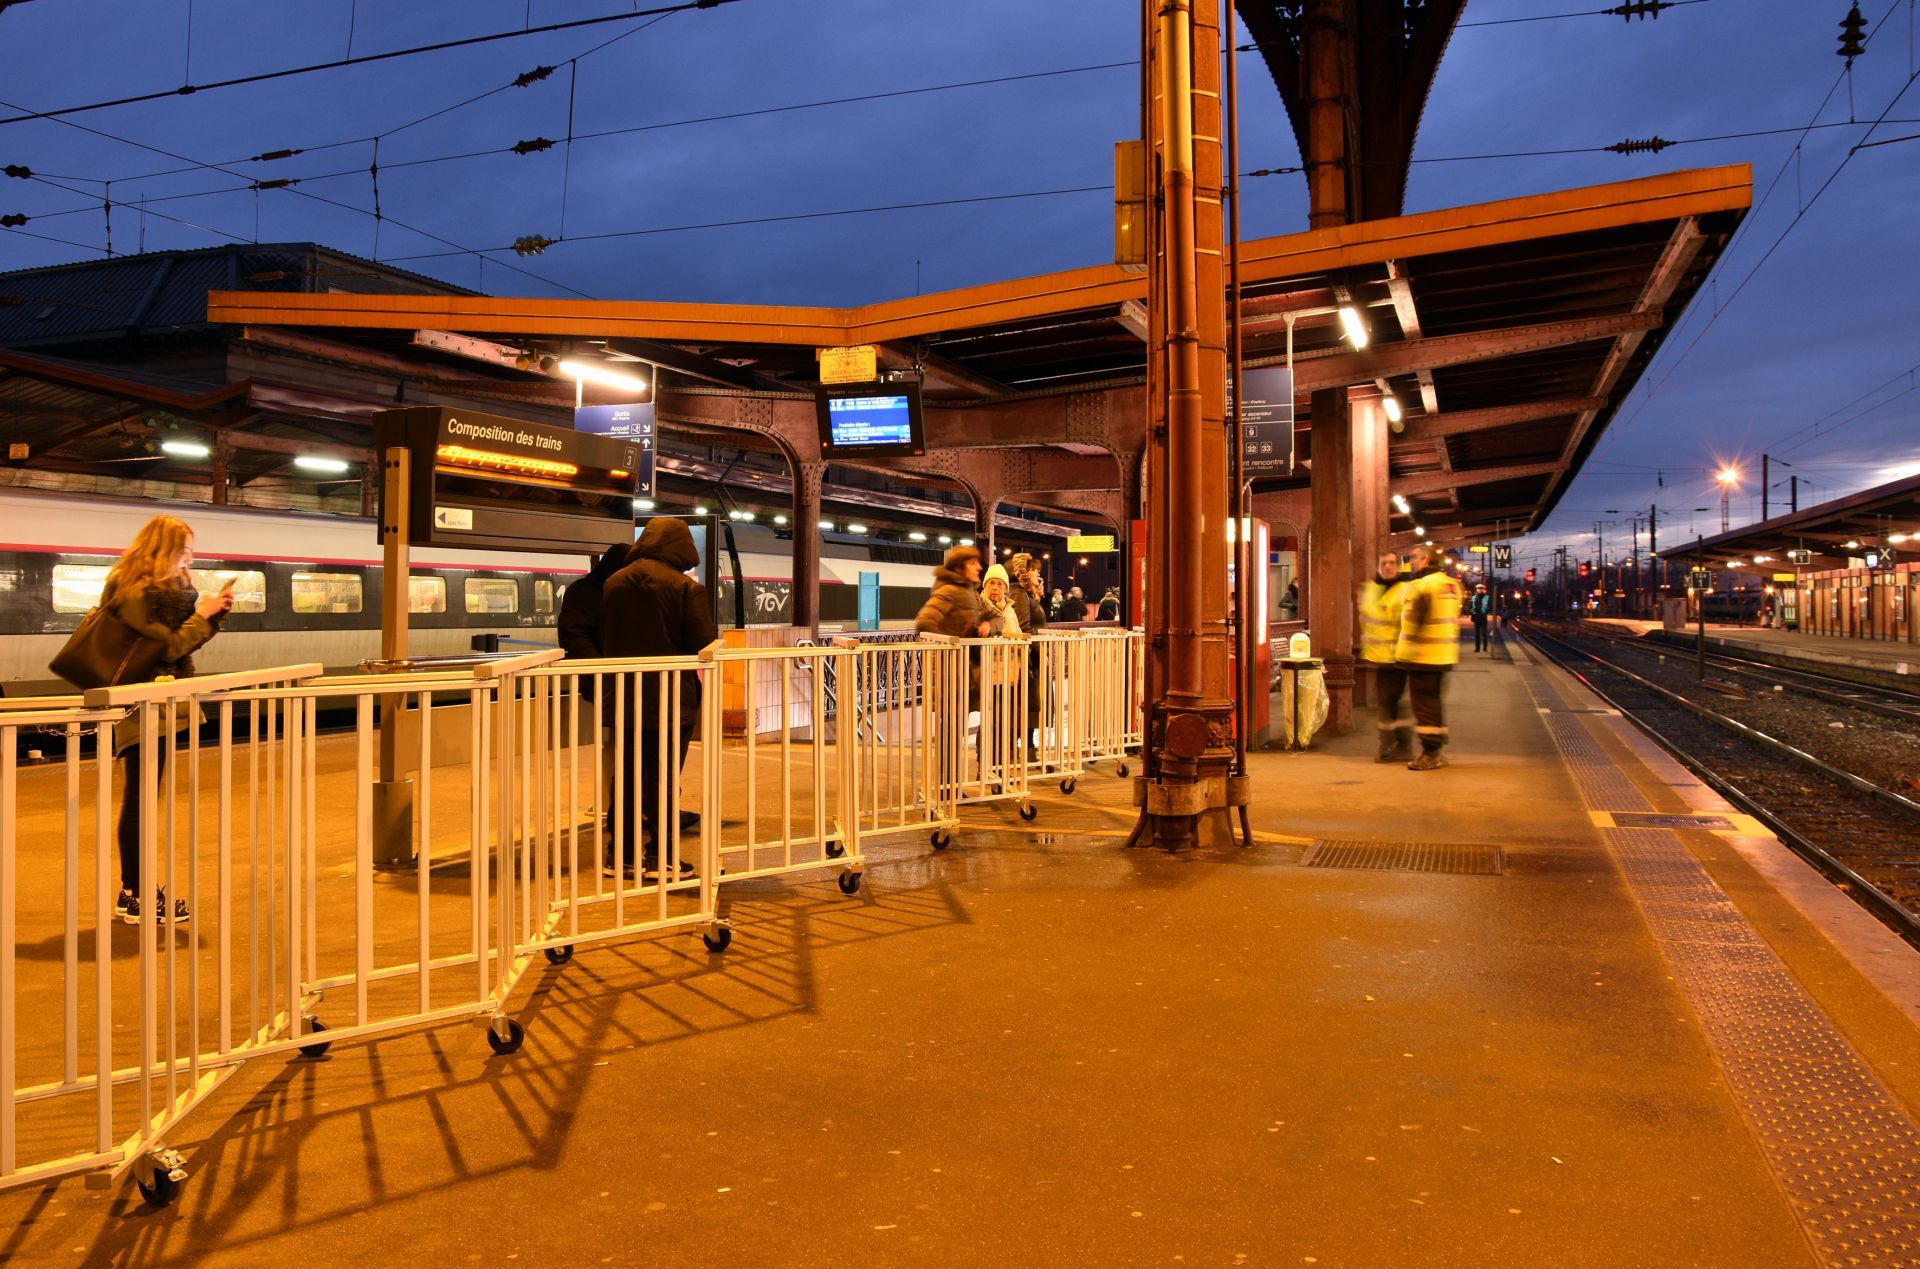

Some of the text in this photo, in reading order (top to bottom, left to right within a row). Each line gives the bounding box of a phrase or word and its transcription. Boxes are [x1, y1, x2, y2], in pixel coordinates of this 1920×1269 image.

[447, 418, 562, 451] Composition des trains
[626, 455, 632, 466] 3
[1495, 548, 1510, 560] W
[1880, 548, 1891, 560] X
[756, 592, 789, 612] TGV
